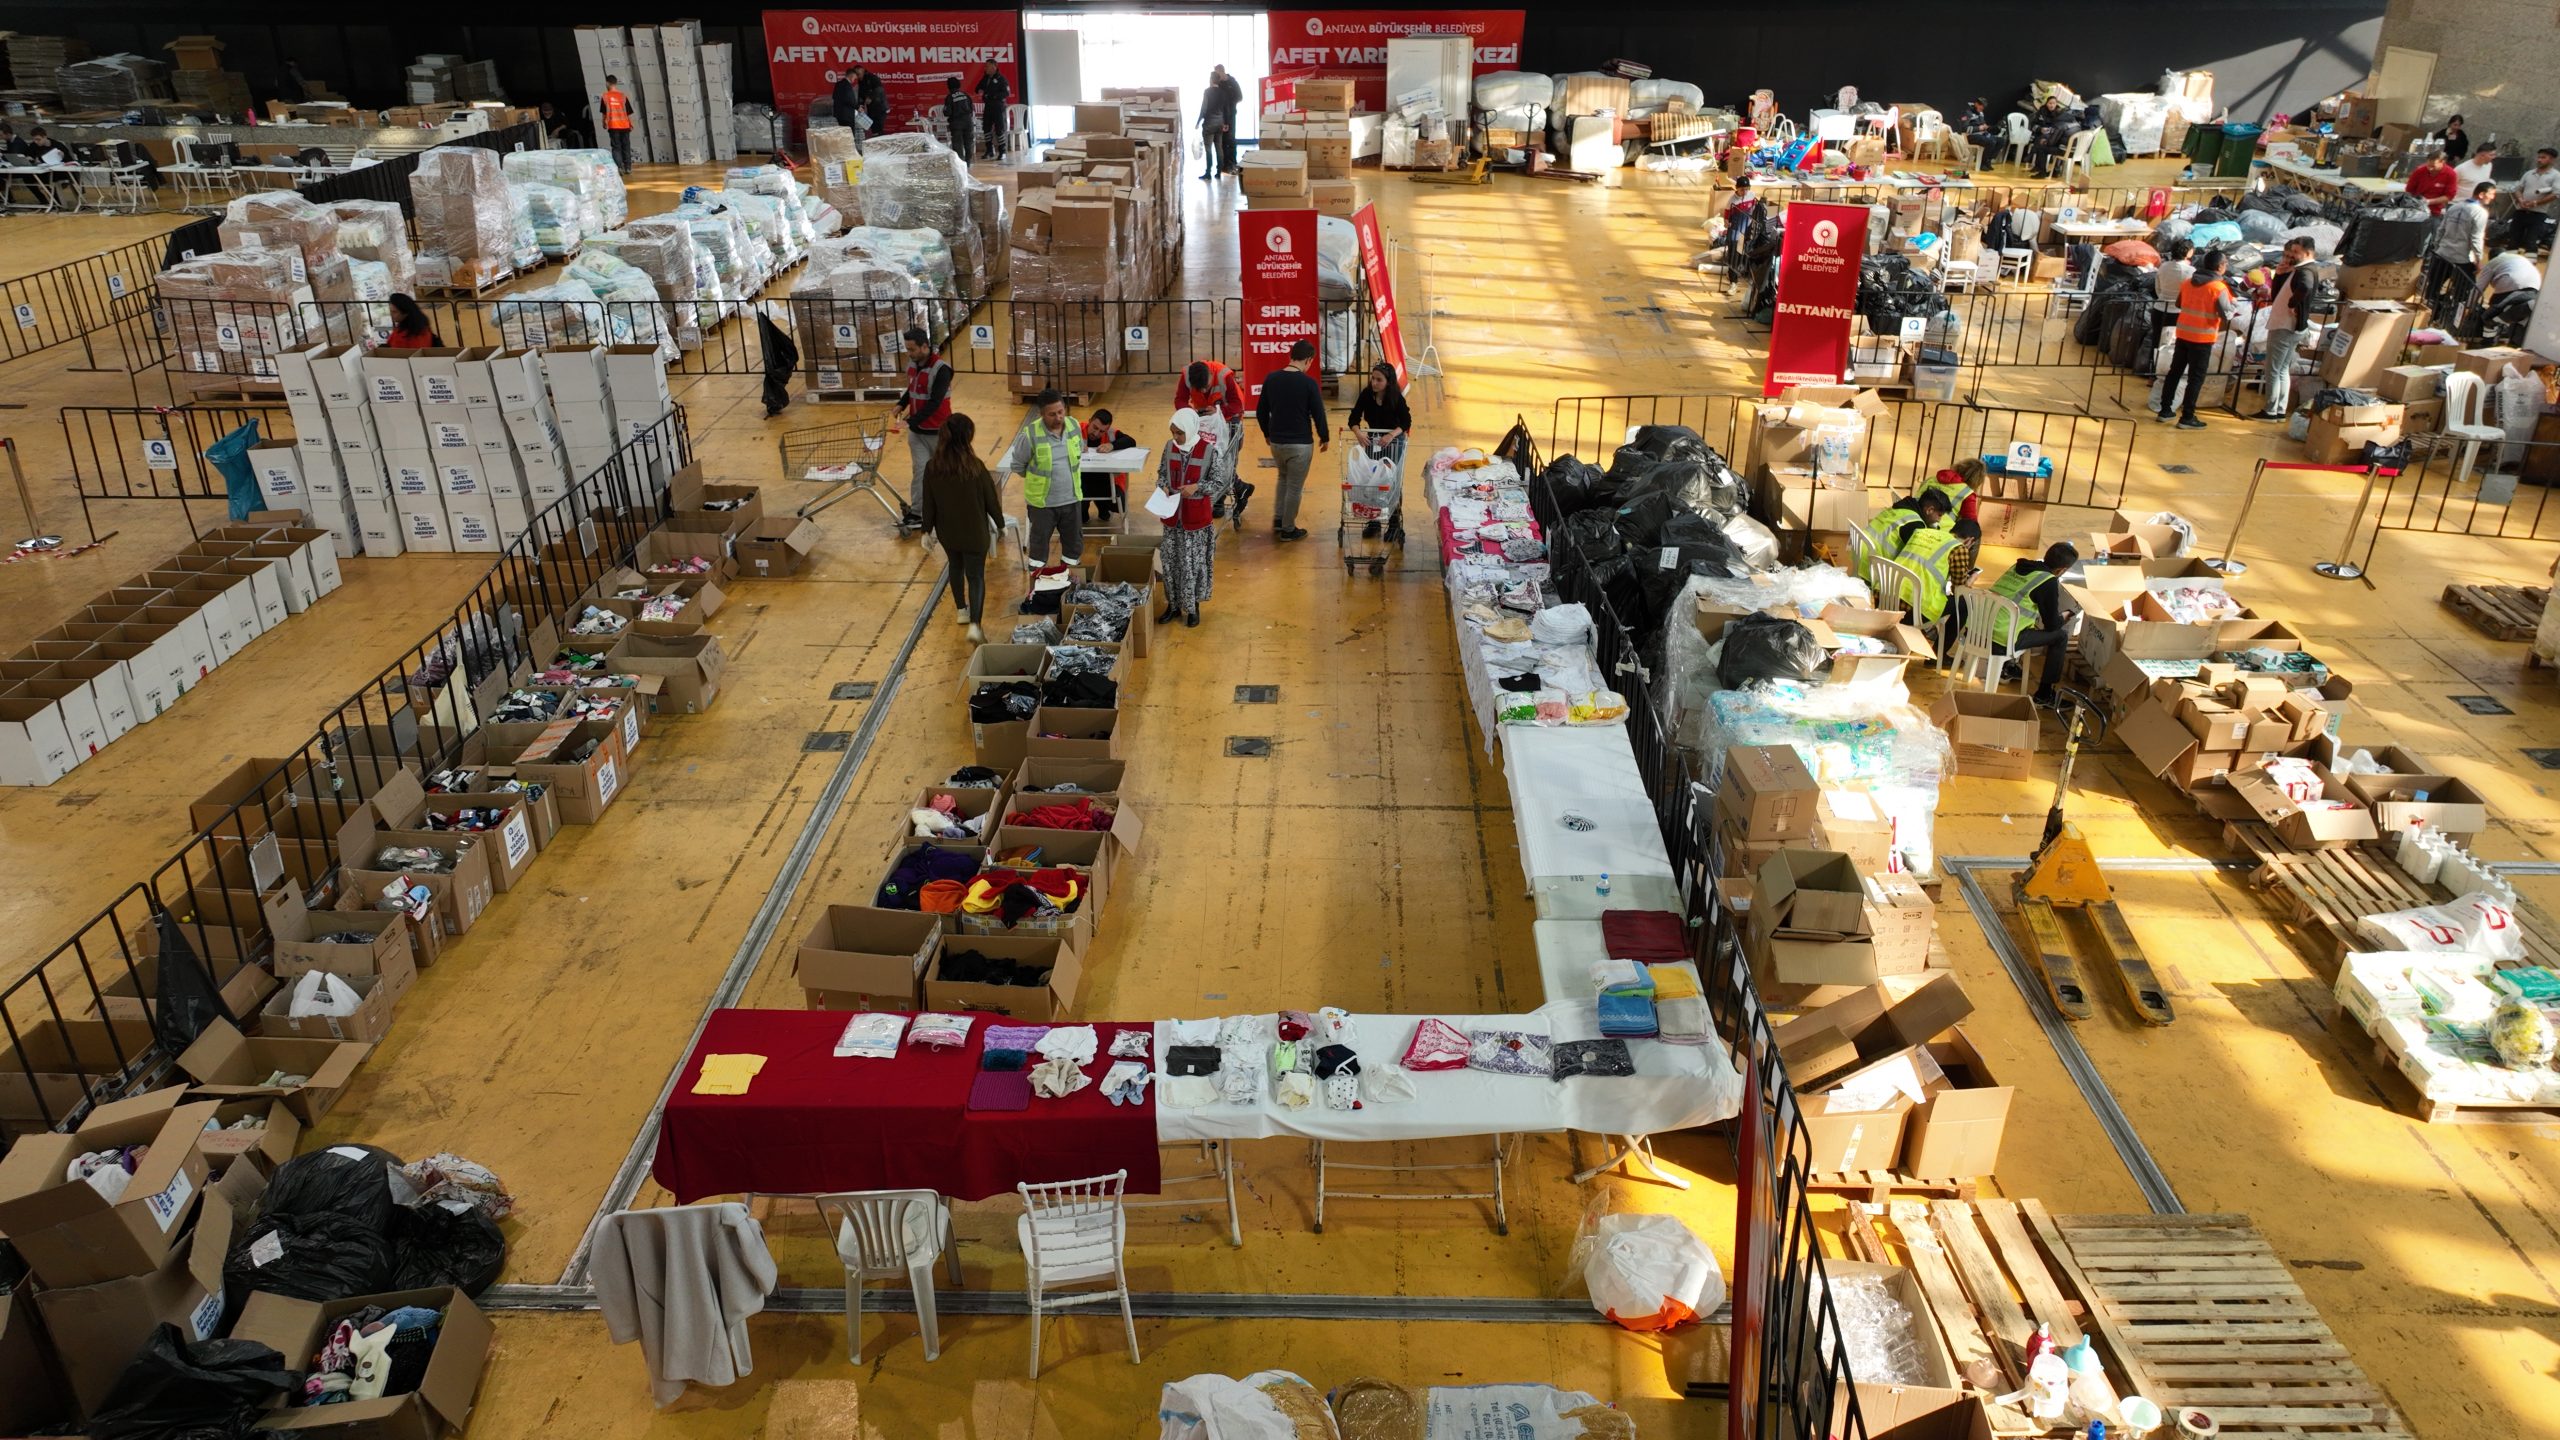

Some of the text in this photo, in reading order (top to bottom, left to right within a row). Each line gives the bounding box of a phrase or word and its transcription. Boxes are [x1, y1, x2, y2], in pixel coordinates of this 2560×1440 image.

[821, 20, 979, 35] ANTALYA BÜYÜKŞEHİR BELEDİYESİ
[1324, 21, 1485, 35] ANTALYA BÜYÜKŞEHİR BELEDİYESİ
[773, 43, 1014, 63] AFET YARDIM MERKEZİ
[1273, 43, 1518, 64] AFET YARD KEZİ
[892, 71, 915, 79] BÖCEK
[1276, 179, 1298, 188] group
[1329, 196, 1351, 205] group
[1807, 247, 1839, 256] ANTALYA
[1256, 261, 1302, 271] BÜYÜKŞEHİR
[1798, 254, 1845, 266] BÜYÜKŞEHİR
[1802, 262, 1839, 273] BELEDİYESİ
[1261, 270, 1298, 279] BELEDİYESİ
[1261, 305, 1301, 318] SIFIR
[1777, 302, 1852, 320] BATTANİYE
[1246, 322, 1317, 337] YETİŞKİN
